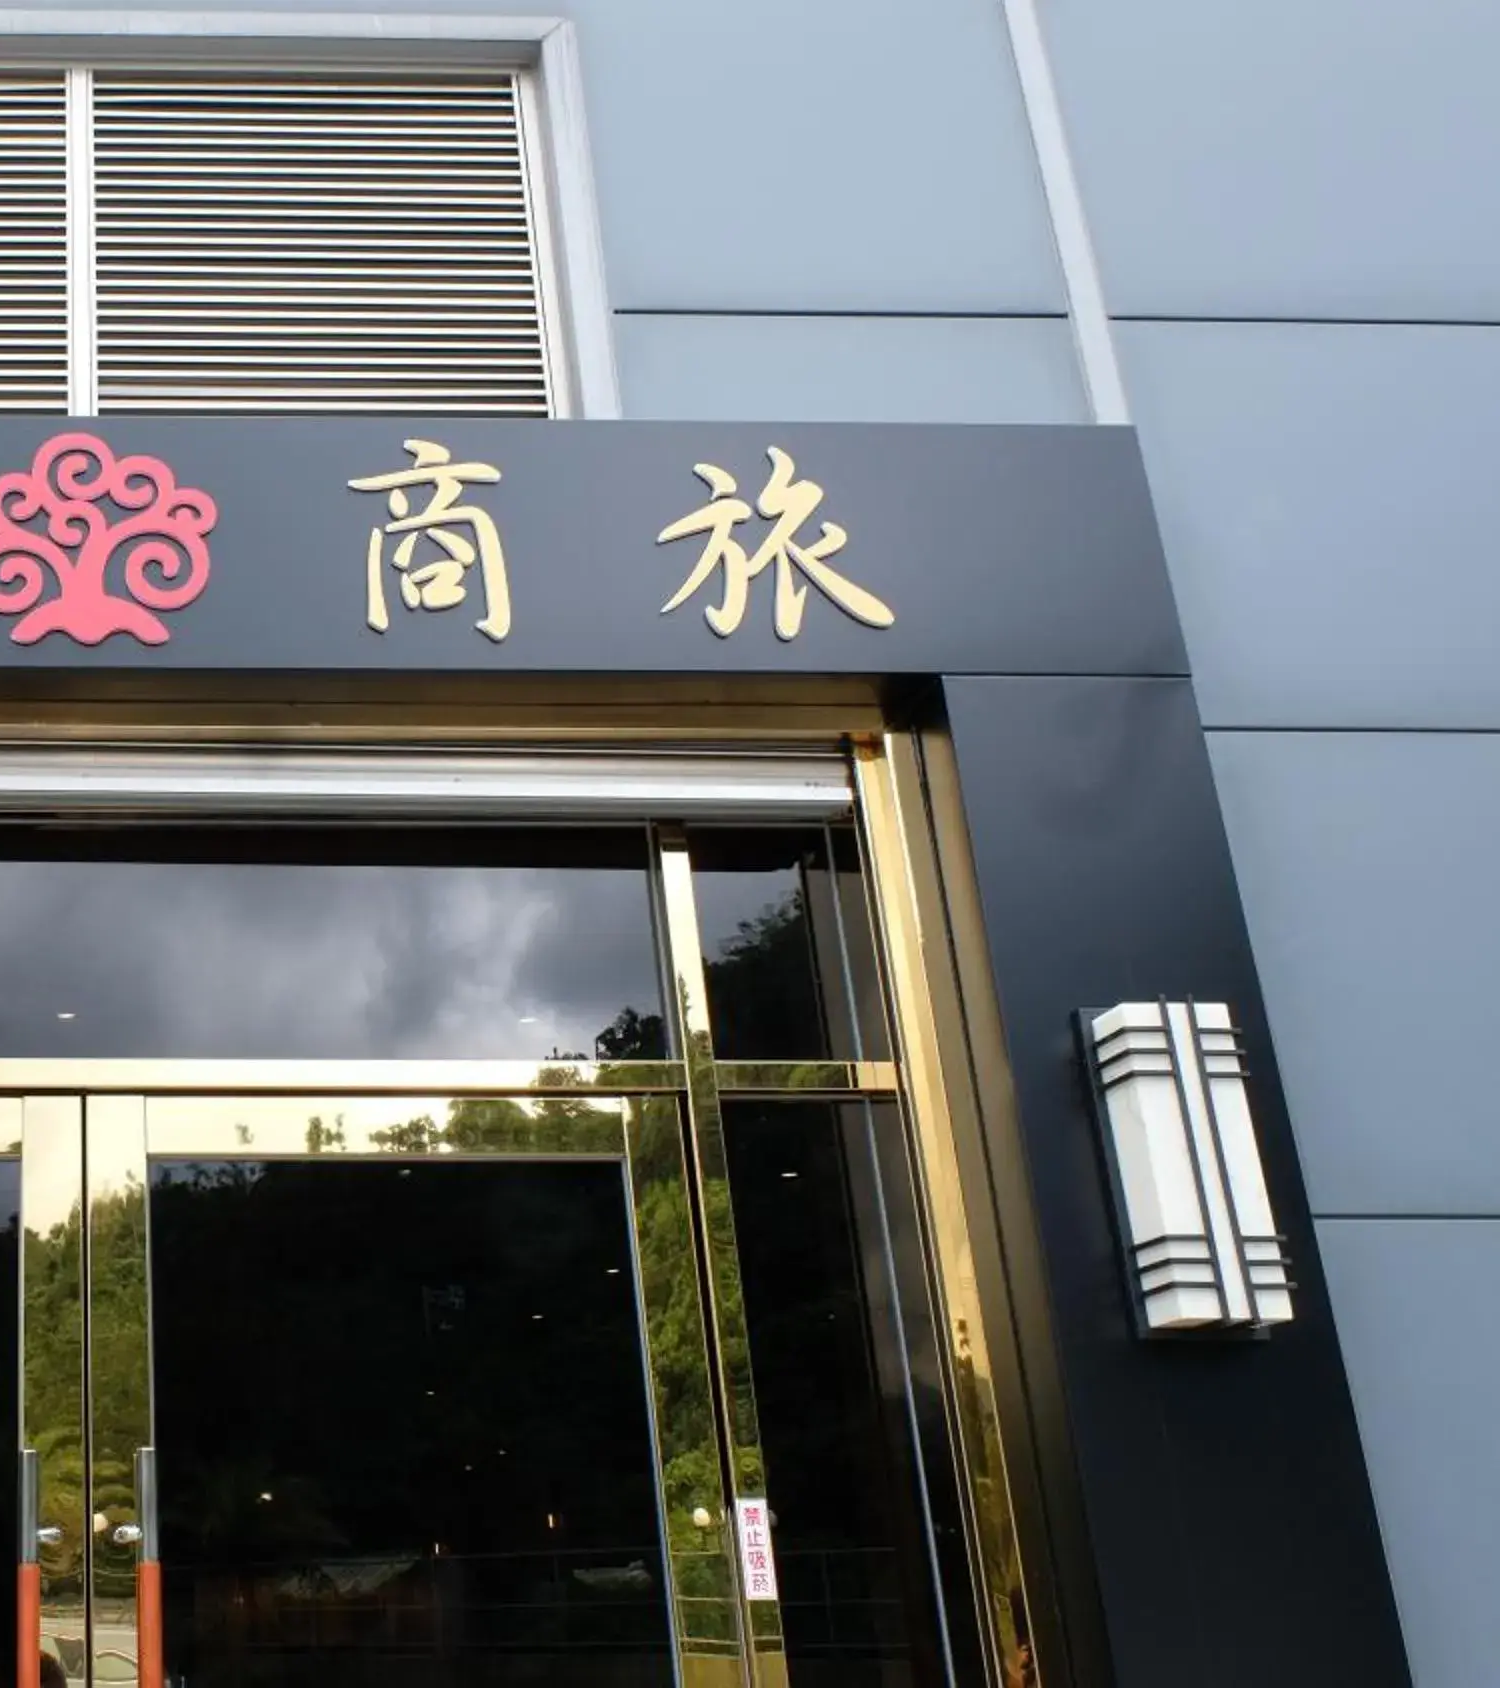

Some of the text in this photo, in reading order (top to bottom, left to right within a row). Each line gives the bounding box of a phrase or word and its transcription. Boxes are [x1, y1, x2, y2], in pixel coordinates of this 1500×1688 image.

[346, 439, 896, 642] 商旅
[743, 1506, 769, 1593] 禁止吸菸
